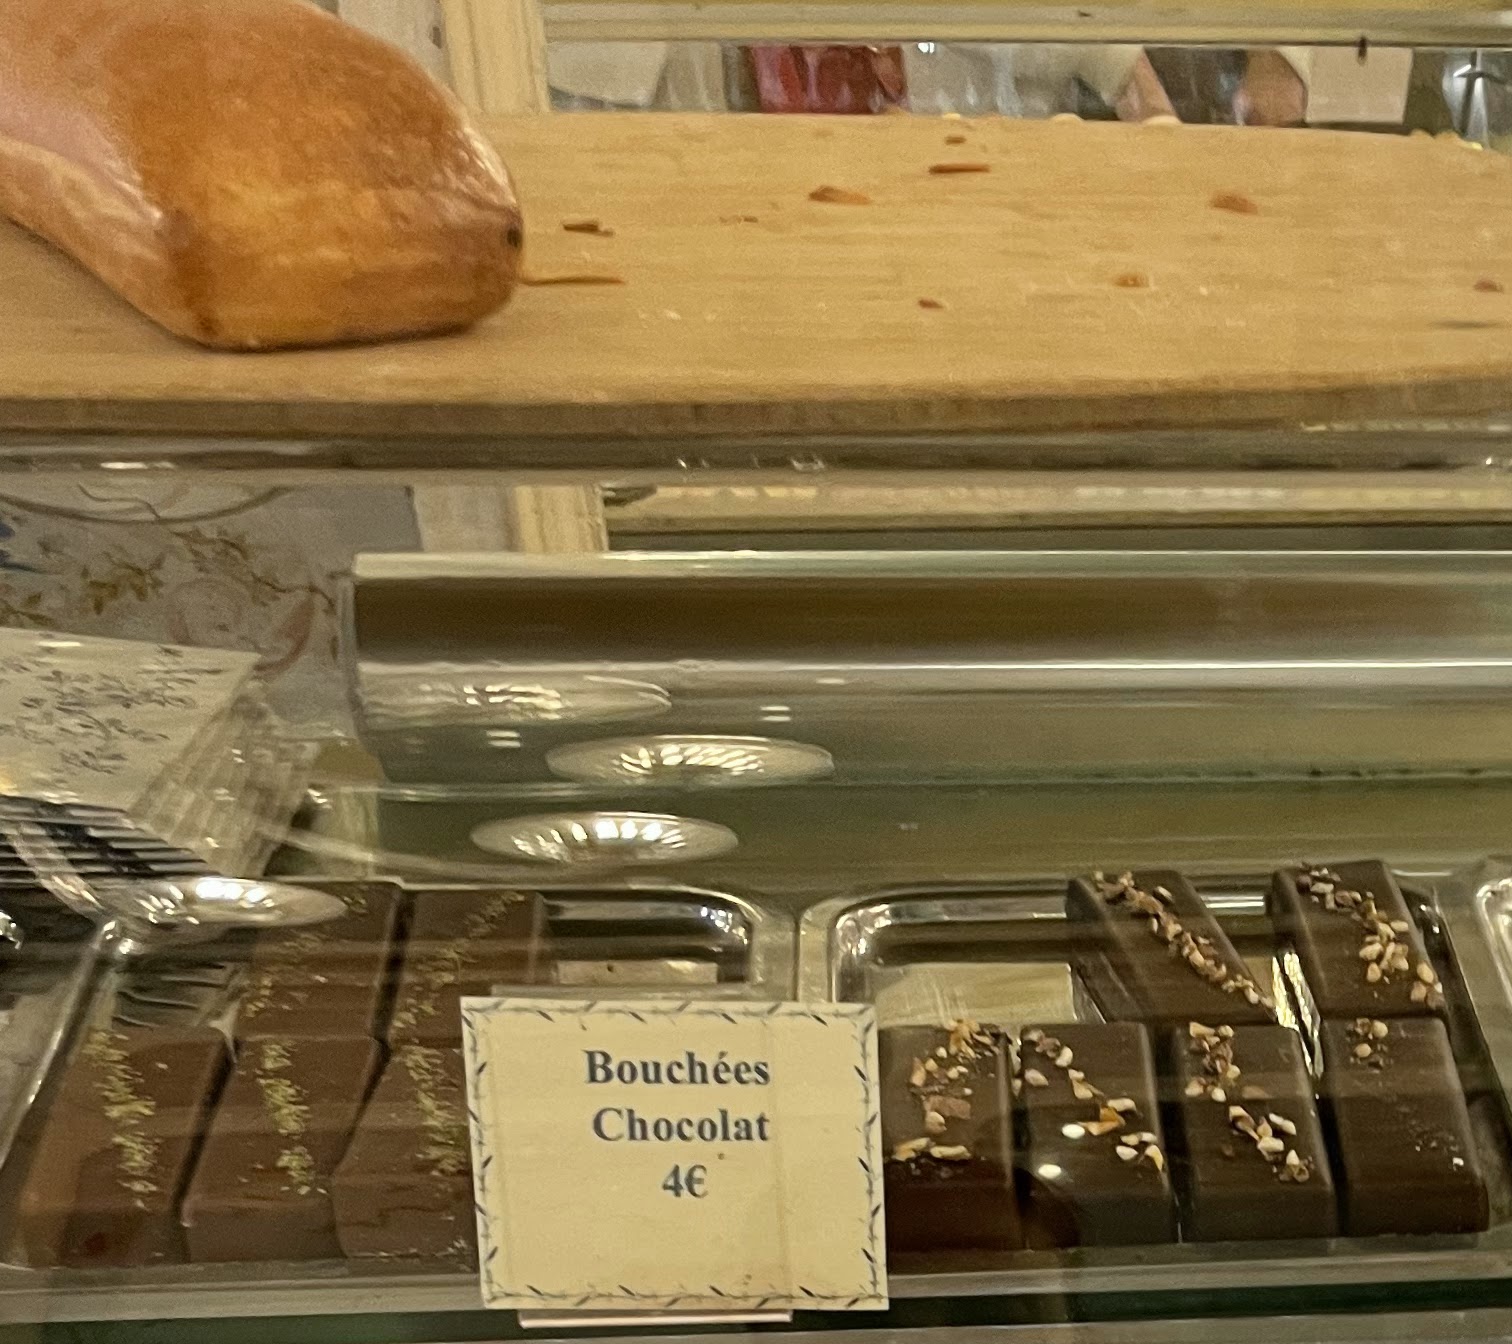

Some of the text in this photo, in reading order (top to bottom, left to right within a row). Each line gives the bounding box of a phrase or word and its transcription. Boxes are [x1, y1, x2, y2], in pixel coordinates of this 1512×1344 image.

[582, 1049, 771, 1085] Bouchées
[592, 1107, 771, 1142] Chocolat
[661, 1164, 709, 1199] 4€
